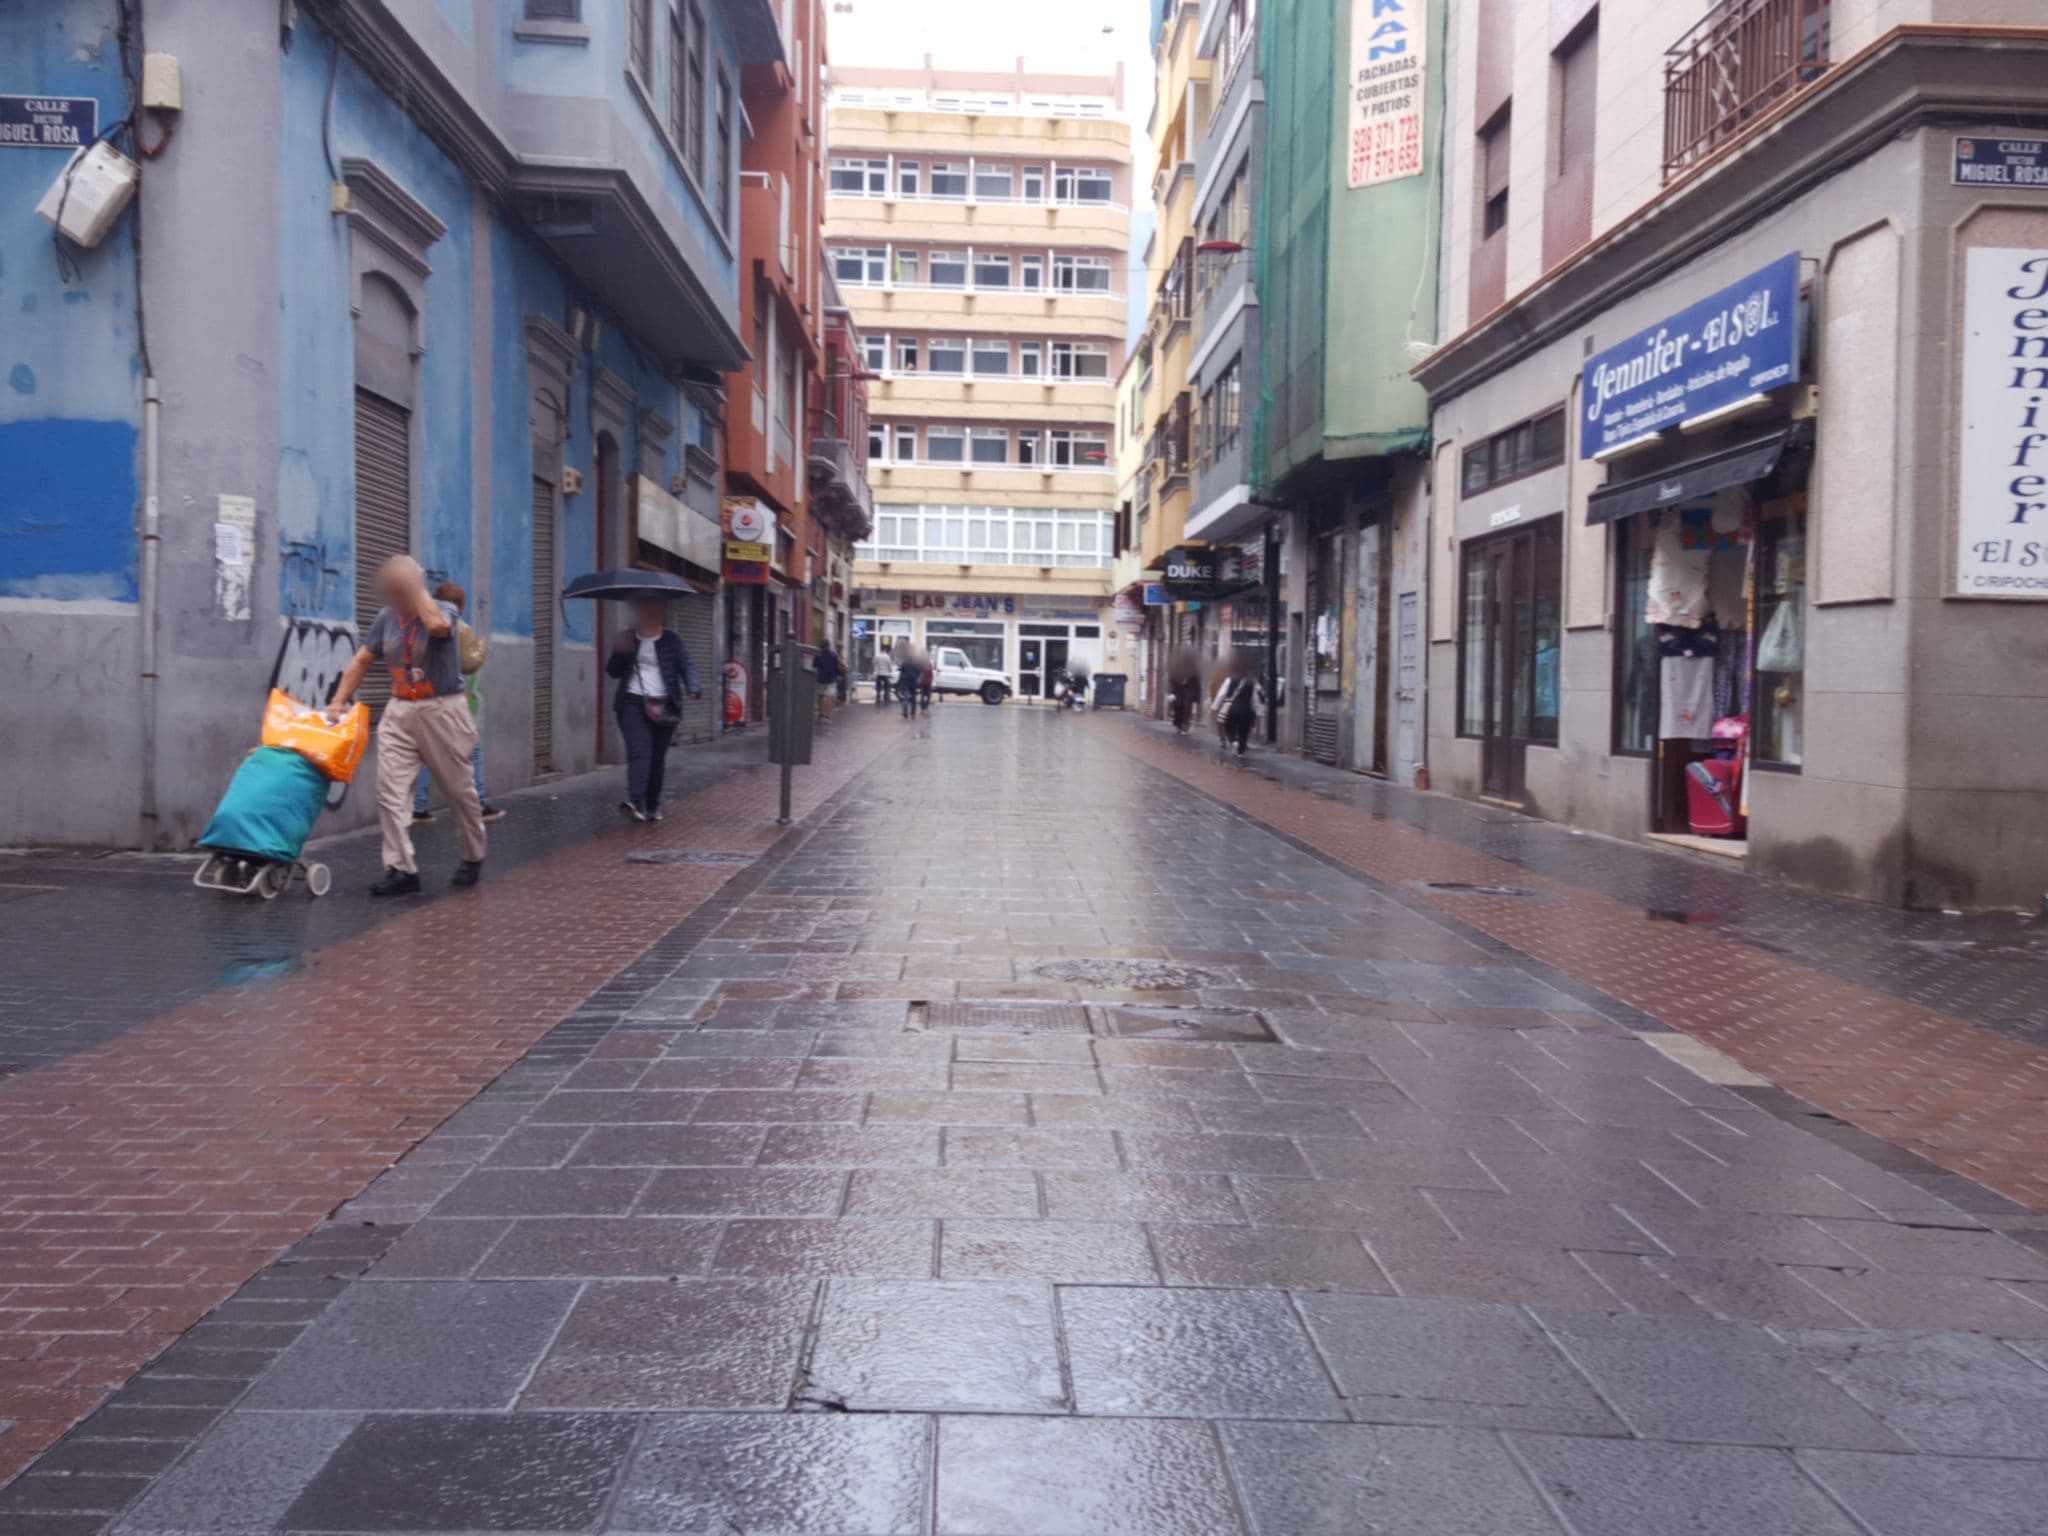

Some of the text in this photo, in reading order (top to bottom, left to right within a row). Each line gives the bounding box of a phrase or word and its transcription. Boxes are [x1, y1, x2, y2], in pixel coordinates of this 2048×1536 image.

[1359, 56, 1417, 83] FACHADAS
[1356, 74, 1418, 102] CUBIERTAS
[24, 101, 70, 112] CALLE
[1362, 96, 1411, 118] Y PATIOS
[43, 125, 80, 143] ROSA
[1353, 114, 1419, 155] 928 371 723
[1998, 142, 2042, 154] CALLE
[1352, 154, 1371, 183] 677
[1399, 143, 1419, 171] 652
[1960, 163, 2048, 184] MIGUEL ROSA
[1587, 328, 1690, 421] Jennifer
[1702, 310, 1728, 354] El
[1971, 539, 2012, 563] El
[1167, 564, 1212, 579] DUKE
[901, 594, 1015, 613] BLAS JEAN'S
